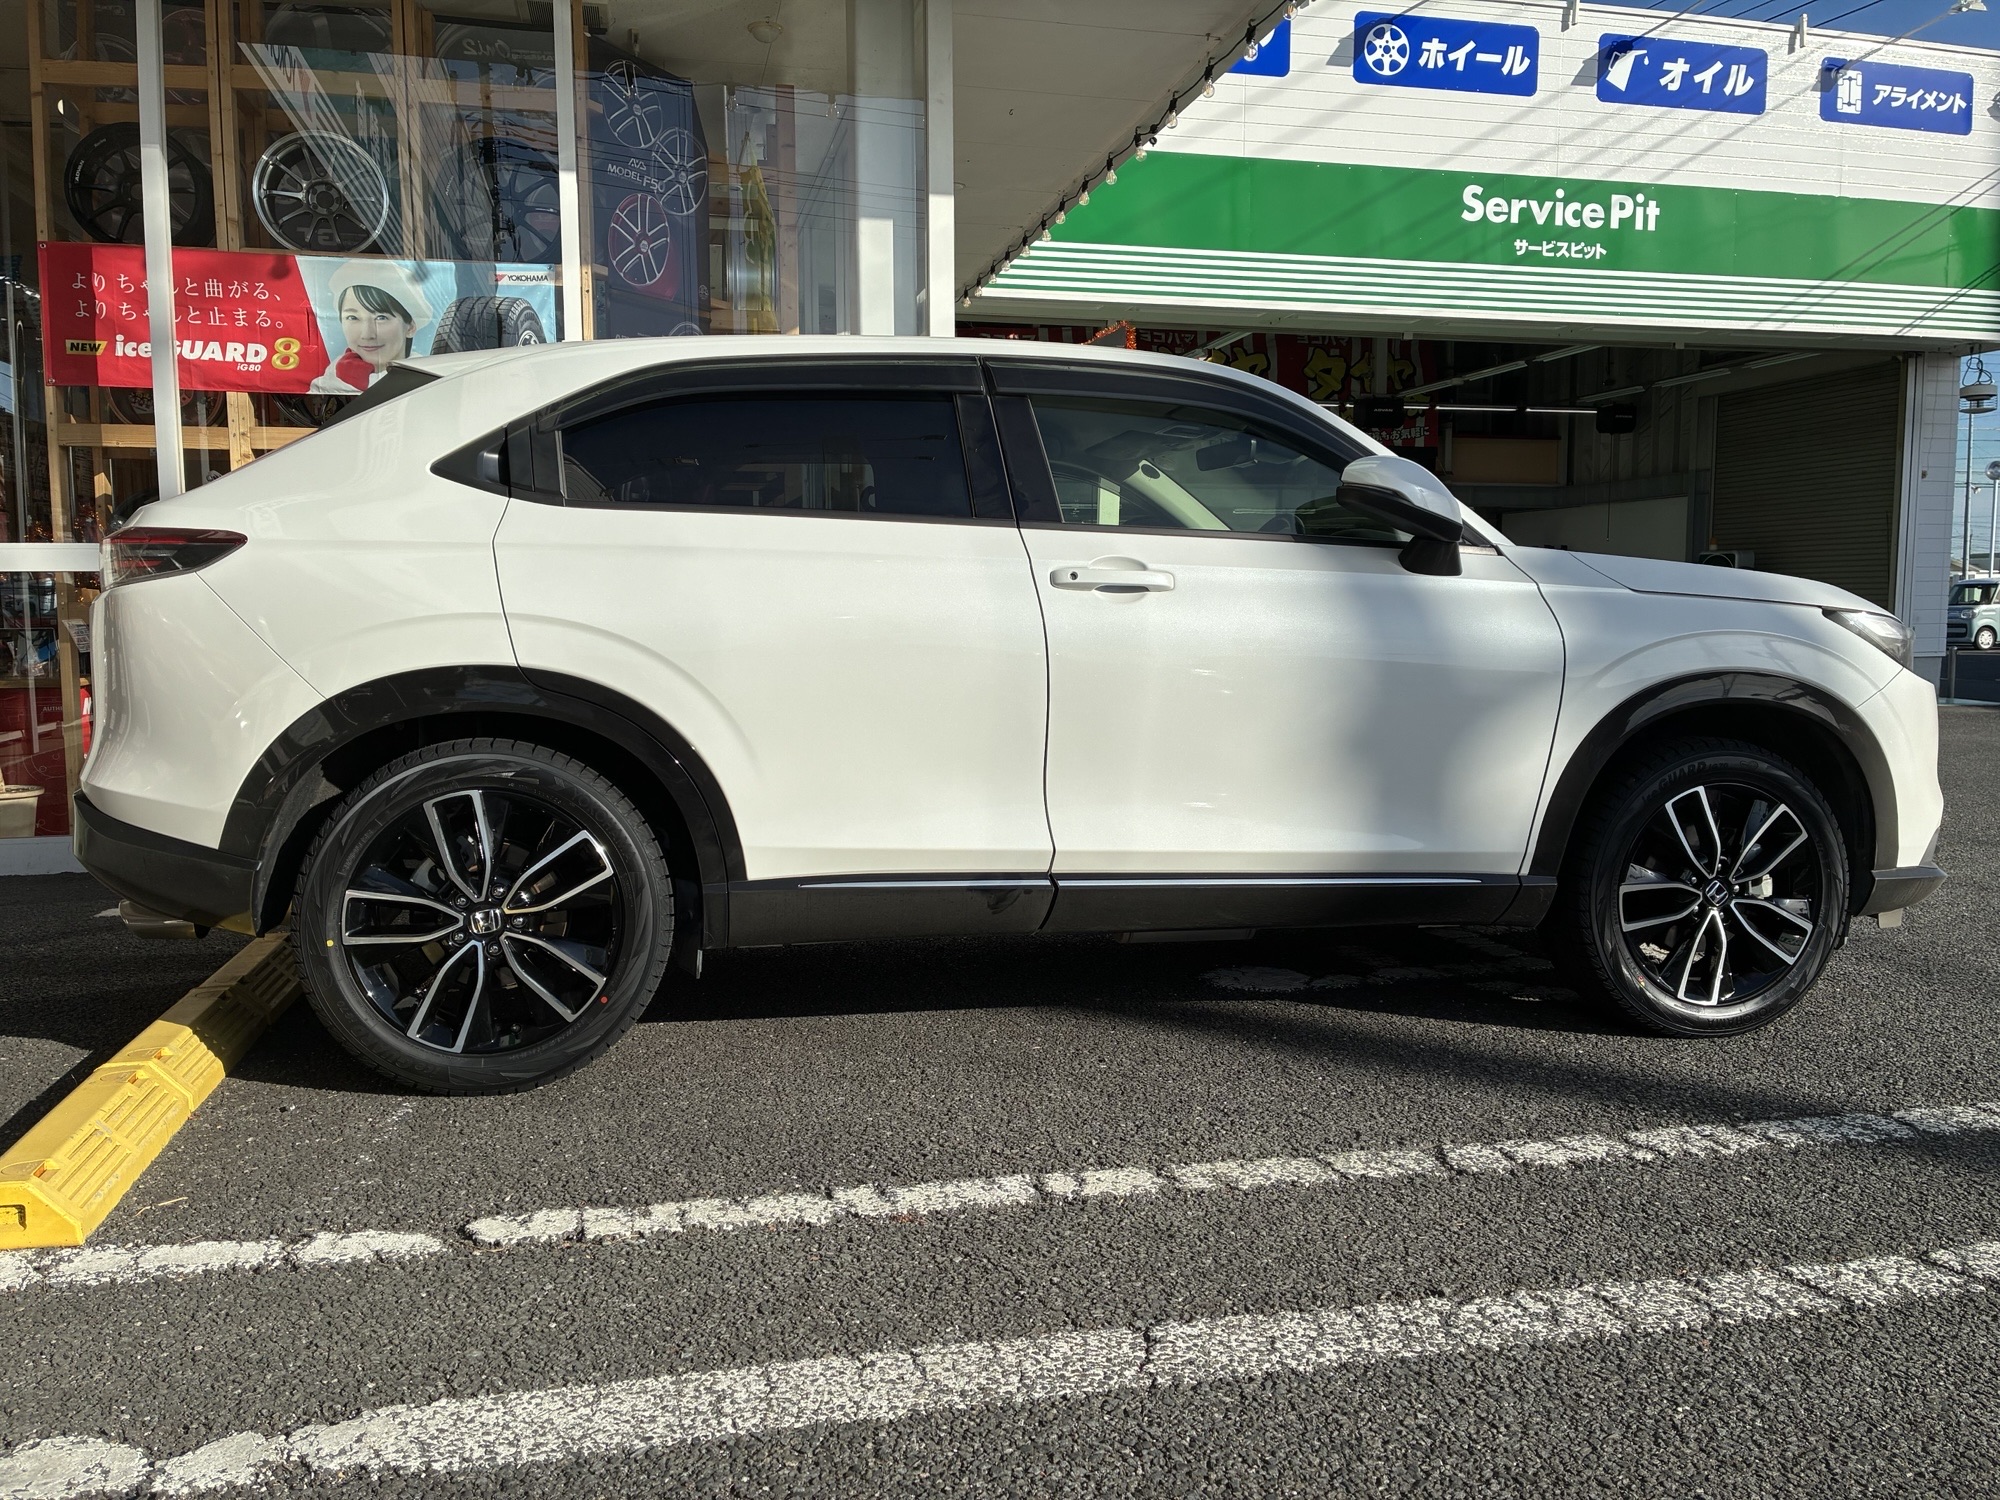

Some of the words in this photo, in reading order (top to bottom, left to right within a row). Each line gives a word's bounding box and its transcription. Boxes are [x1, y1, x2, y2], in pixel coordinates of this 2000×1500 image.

[1419, 38, 1531, 76] ホイール
[1659, 57, 1755, 97] オイル
[1872, 84, 1968, 114] アライメント
[607, 163, 643, 182] MODEL
[642, 175, 666, 193] F50
[1461, 184, 1605, 229] Service
[1610, 192, 1661, 232] Pit
[1513, 238, 1607, 260] サービスピット
[507, 274, 549, 283] YOKOHAMA
[69, 341, 102, 353] NEW
[271, 337, 301, 371] 8
[236, 362, 262, 373] iG80
